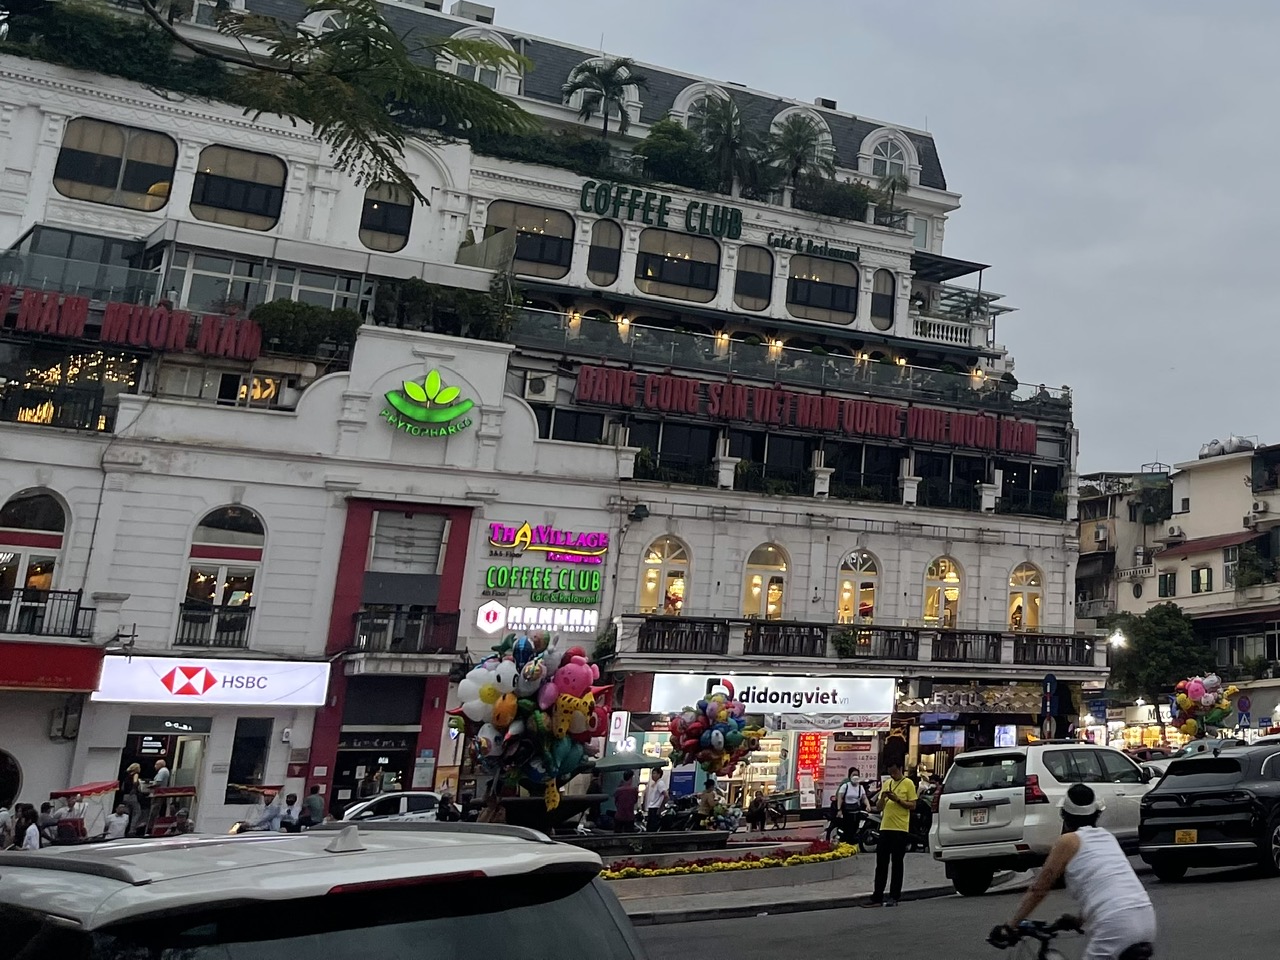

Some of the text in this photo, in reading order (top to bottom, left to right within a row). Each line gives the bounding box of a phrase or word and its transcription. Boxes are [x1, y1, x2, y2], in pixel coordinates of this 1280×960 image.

[580, 180, 743, 240] COFFEE CLUB
[807, 239, 860, 262] Restaurant
[796, 393, 840, 430] NAM
[841, 399, 901, 439] QUANG
[906, 406, 948, 442] VINH
[487, 566, 601, 592] COFFEE CLUB
[559, 592, 600, 605] Restaurant
[222, 676, 269, 689] HSBC
